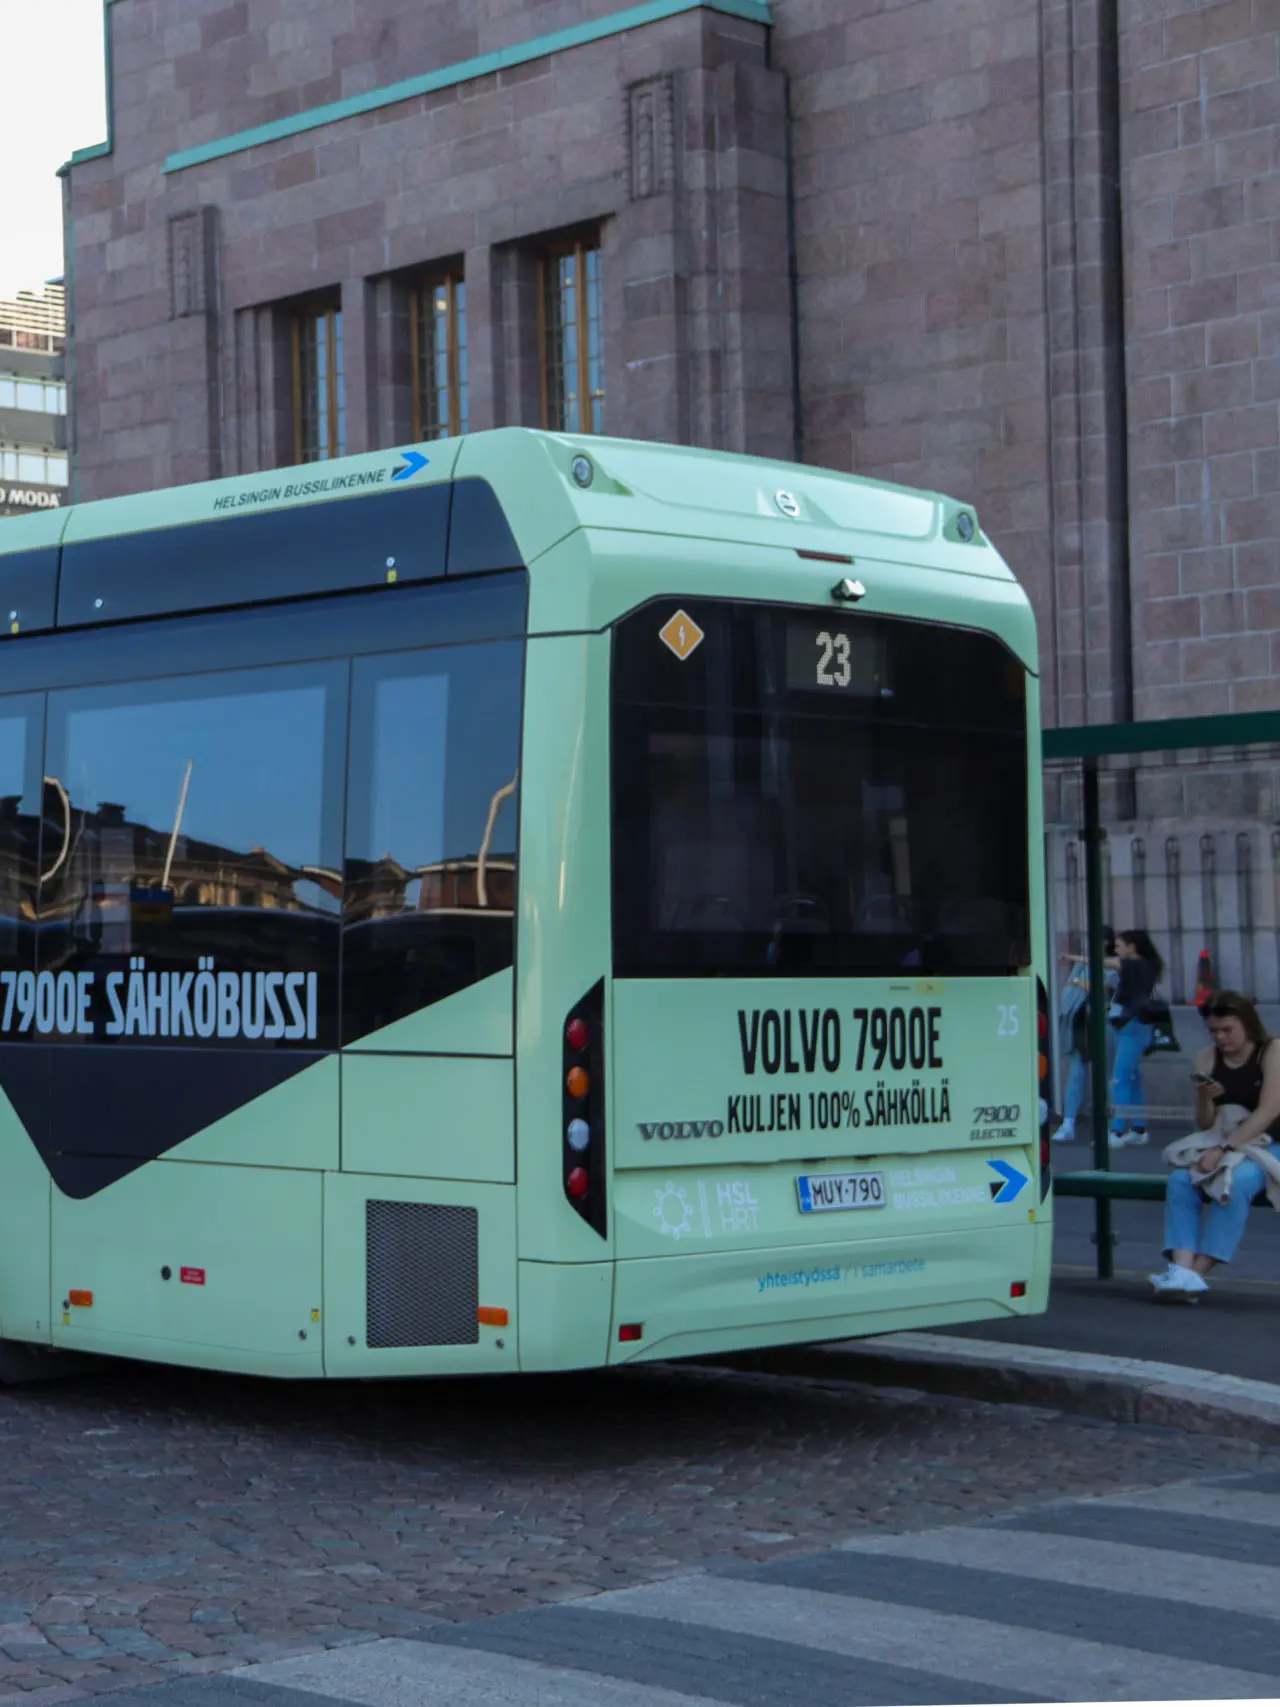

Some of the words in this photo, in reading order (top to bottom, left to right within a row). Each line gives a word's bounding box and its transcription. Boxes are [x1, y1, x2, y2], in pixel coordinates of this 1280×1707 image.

[9, 489, 60, 508] MODA
[213, 487, 282, 511] HELSINGIN
[282, 468, 387, 498] BUSSILIIKENNE
[816, 631, 851, 687] 23
[0, 970, 94, 1034] 7900E
[105, 956, 317, 1039] SÄHKÖBUSSI
[996, 1004, 1019, 1036] 25
[737, 1008, 841, 1075] VOLVO
[853, 1006, 943, 1071] 7900E
[727, 1092, 801, 1134] KULJEN
[808, 1089, 861, 1130] 100%
[864, 1078, 951, 1127] SÄHKÖLLÄ
[972, 1104, 1020, 1125] 7900
[636, 1119, 725, 1141] VOLVO
[969, 1127, 1018, 1141] ELECTRIC
[716, 1181, 757, 1206] HSL
[811, 1177, 882, 1206] MUY-790
[720, 1205, 761, 1233] HRT
[757, 1264, 841, 1293] yhteistyössä
